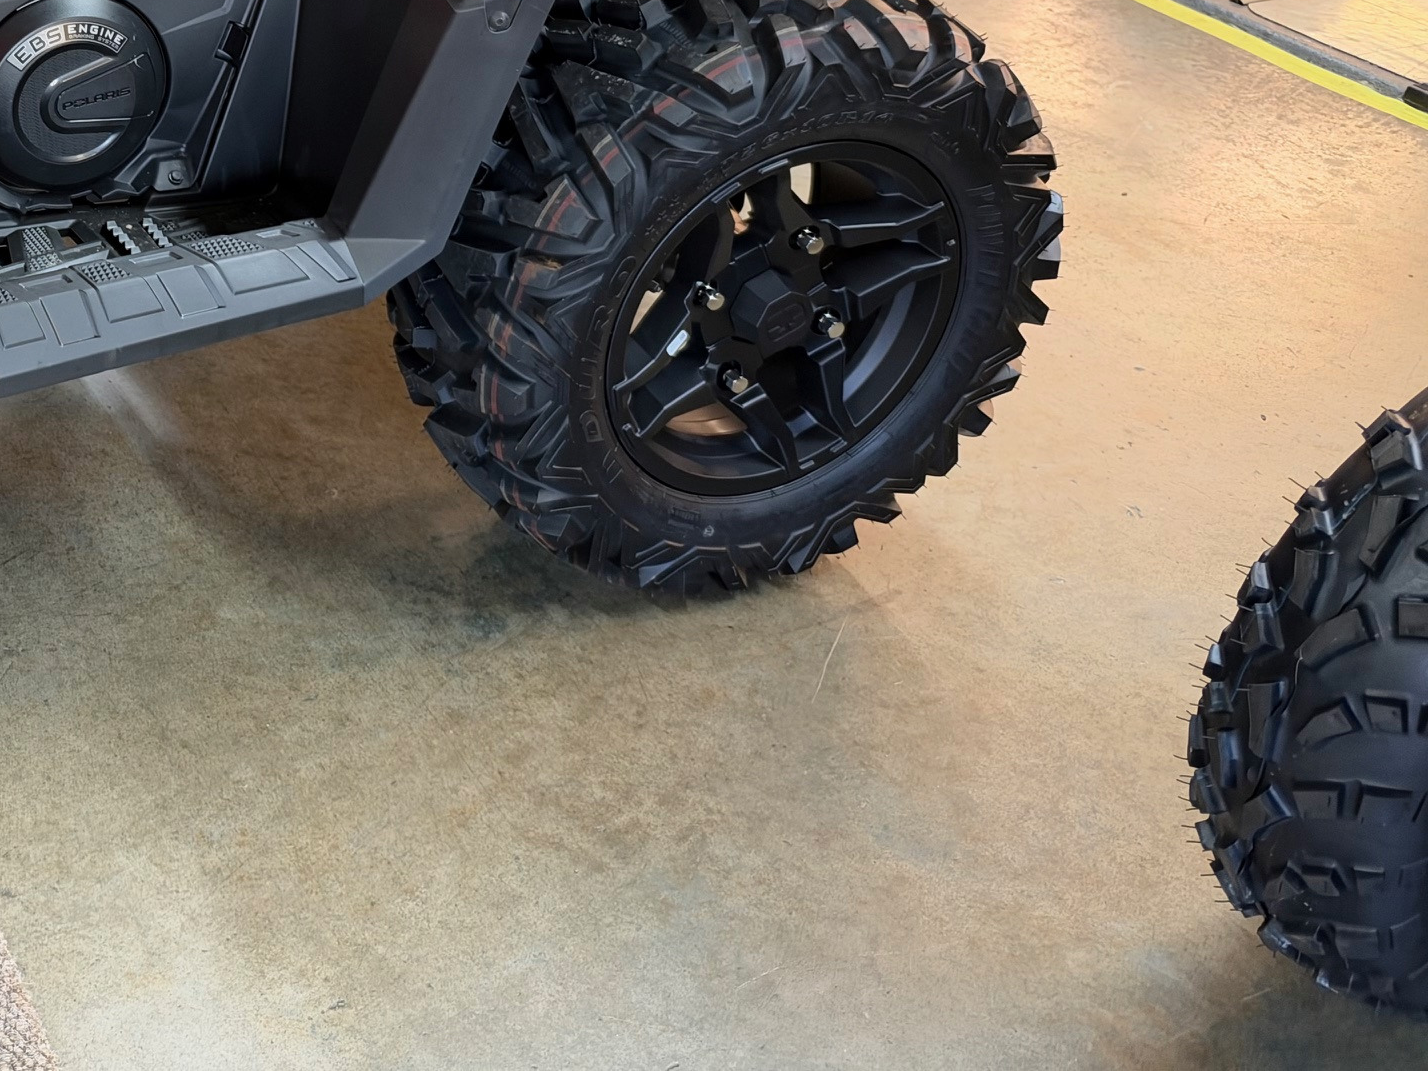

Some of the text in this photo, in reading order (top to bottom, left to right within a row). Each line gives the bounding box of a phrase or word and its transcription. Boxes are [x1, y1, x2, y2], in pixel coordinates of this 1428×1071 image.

[13, 23, 124, 65] EBS ENGINE
[62, 86, 131, 111] POLARIS
